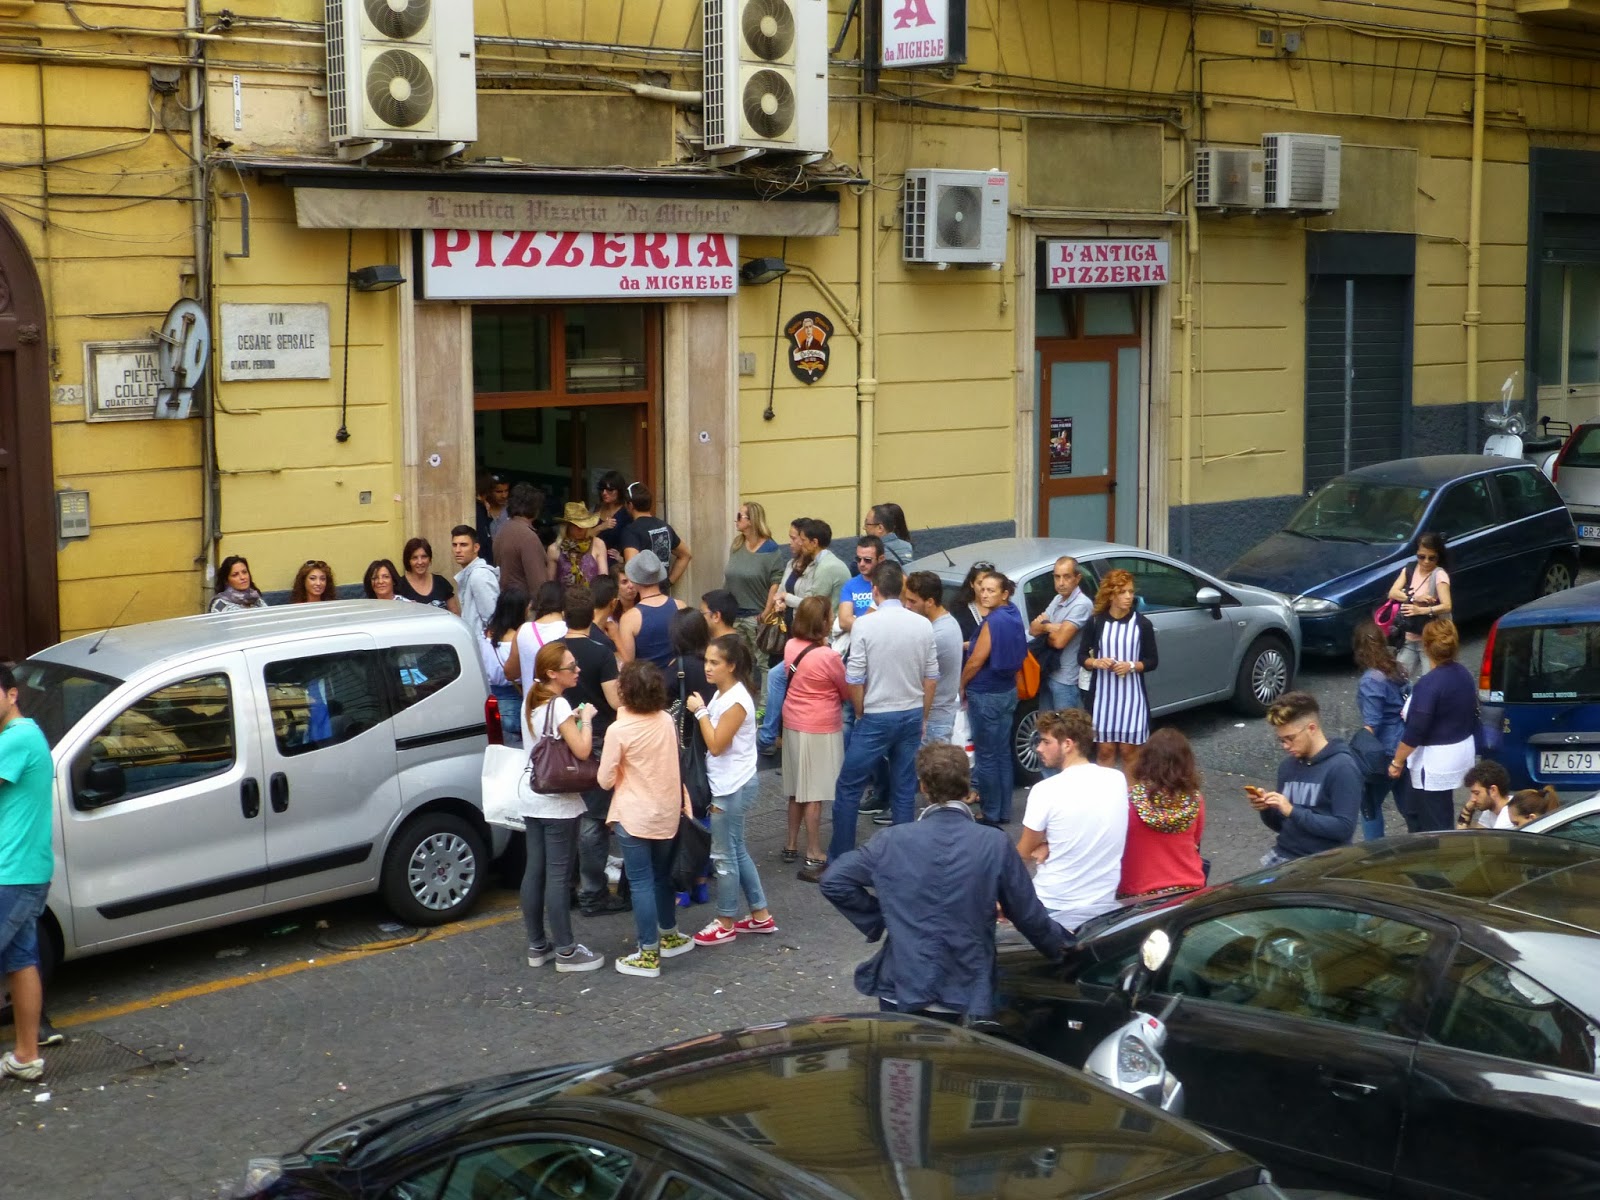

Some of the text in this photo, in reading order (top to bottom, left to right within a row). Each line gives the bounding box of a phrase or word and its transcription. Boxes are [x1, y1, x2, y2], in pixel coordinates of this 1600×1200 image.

[884, 38, 944, 61] da MICHELE
[526, 199, 608, 226] Pizzeria
[431, 229, 733, 269] PIZZERIA
[1060, 244, 1158, 263] L'ANTICA
[1051, 264, 1167, 284] PIZZERIA
[619, 275, 733, 290] da MICHELE
[268, 312, 284, 326] VIA
[237, 334, 315, 350] CESARE SERSALE
[135, 354, 154, 368] VIA
[58, 387, 75, 401] 23
[105, 397, 149, 408] QUARTIERE
[1584, 526, 1594, 537] BR
[1543, 754, 1559, 769] AZ
[1567, 754, 1593, 769] 679
